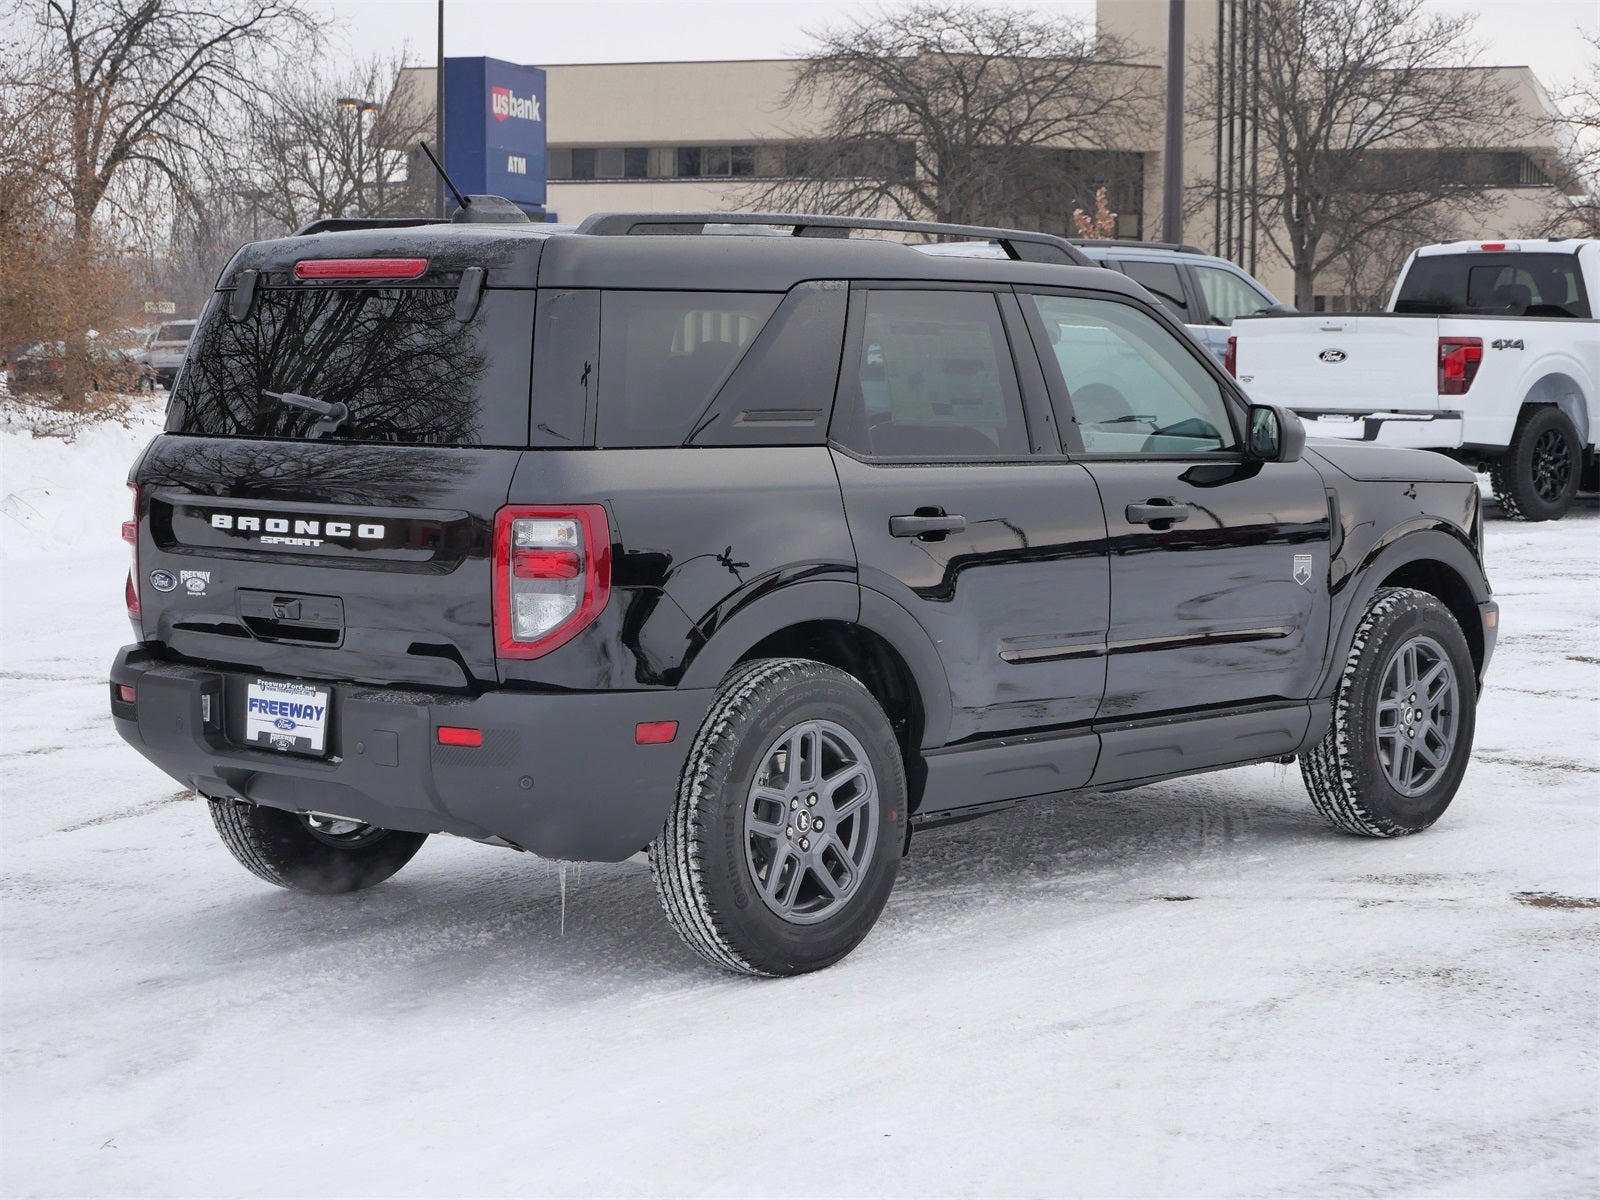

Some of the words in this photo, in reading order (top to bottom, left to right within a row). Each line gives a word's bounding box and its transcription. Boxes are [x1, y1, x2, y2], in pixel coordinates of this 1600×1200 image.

[507, 155, 527, 175] ATM
[1322, 351, 1343, 361] Ford
[211, 513, 385, 539] BRONCO
[260, 535, 324, 547] SPORT
[152, 573, 170, 587] Ford
[180, 570, 211, 585] FREEWAY
[248, 697, 325, 721] FREEWAY
[277, 719, 293, 729] Ford
